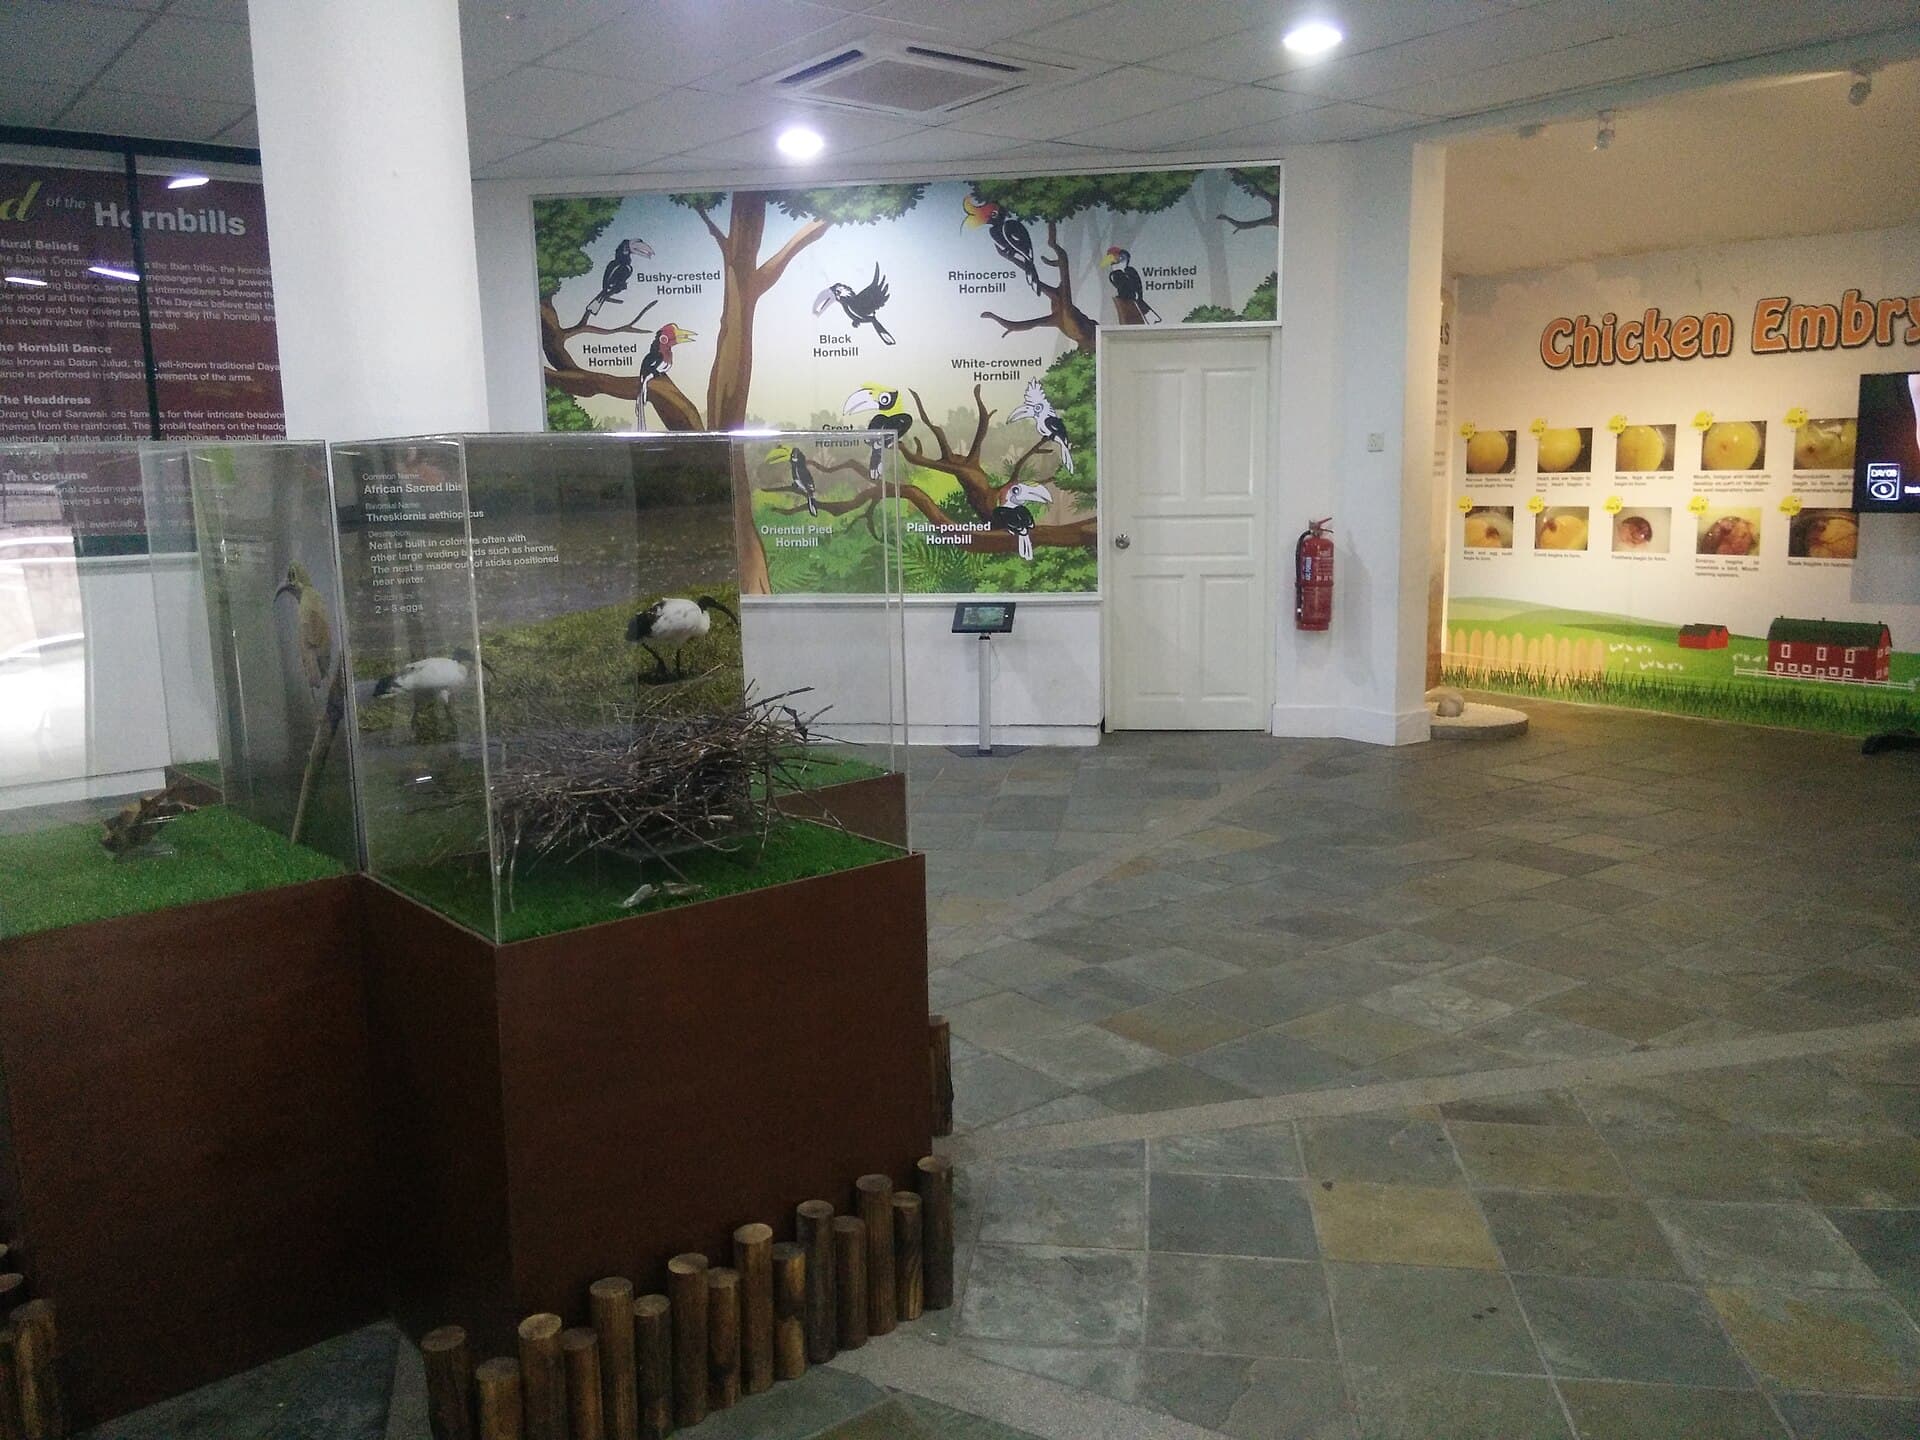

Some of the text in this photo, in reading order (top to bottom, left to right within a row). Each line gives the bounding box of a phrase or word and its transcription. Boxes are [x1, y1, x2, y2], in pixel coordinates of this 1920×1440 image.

[47, 198, 60, 208] of
[65, 198, 86, 209] the
[94, 201, 246, 235] Hornbills
[36, 241, 79, 252] Beliefs
[637, 270, 721, 284] Bushy-crested
[948, 269, 1017, 281] Rhinoceros
[1142, 265, 1197, 278] Wrinkled
[657, 284, 702, 296] Hornbill
[958, 282, 1006, 294] Hornbill
[1145, 279, 1194, 291] Hornbill
[819, 334, 852, 344] Black
[1540, 307, 1734, 371] Chicken
[18, 341, 69, 353] Hornbill
[73, 343, 112, 354] Dance
[583, 343, 637, 354] Helmeted
[813, 346, 859, 358] Hornbill
[209, 360, 255, 371] traditional
[588, 356, 633, 367] Hornbill
[951, 356, 1042, 370] White-crowned
[38, 370, 90, 381] performed
[973, 370, 1020, 382] Hornbill
[23, 393, 91, 405] Headdress
[207, 410, 245, 420] intricate
[815, 437, 859, 448] Hornbill
[31, 472, 89, 482] Costume
[362, 472, 397, 481] Common
[363, 483, 403, 495] African
[405, 482, 443, 493] Sacred
[366, 508, 485, 522] Threskiornis aethiopcus
[760, 524, 833, 535] Oriental Pied
[906, 521, 991, 534] Plain-pouched
[369, 532, 527, 551] Nest is built in often with
[775, 537, 818, 548] Hornbill
[926, 534, 972, 546] Hornbill
[370, 551, 396, 563] other
[398, 549, 423, 562] large
[424, 548, 459, 560] wading
[488, 545, 511, 556] such
[512, 546, 523, 554] as
[525, 543, 557, 554] herons.
[371, 564, 390, 575] The
[392, 561, 414, 573] nest
[415, 561, 425, 572] is
[426, 560, 453, 571] made
[474, 559, 484, 569] of
[485, 556, 513, 568] sticks
[513, 553, 560, 567] positioned
[372, 574, 427, 588] near water.
[375, 605, 382, 615] 2
[400, 602, 425, 615] eggs
